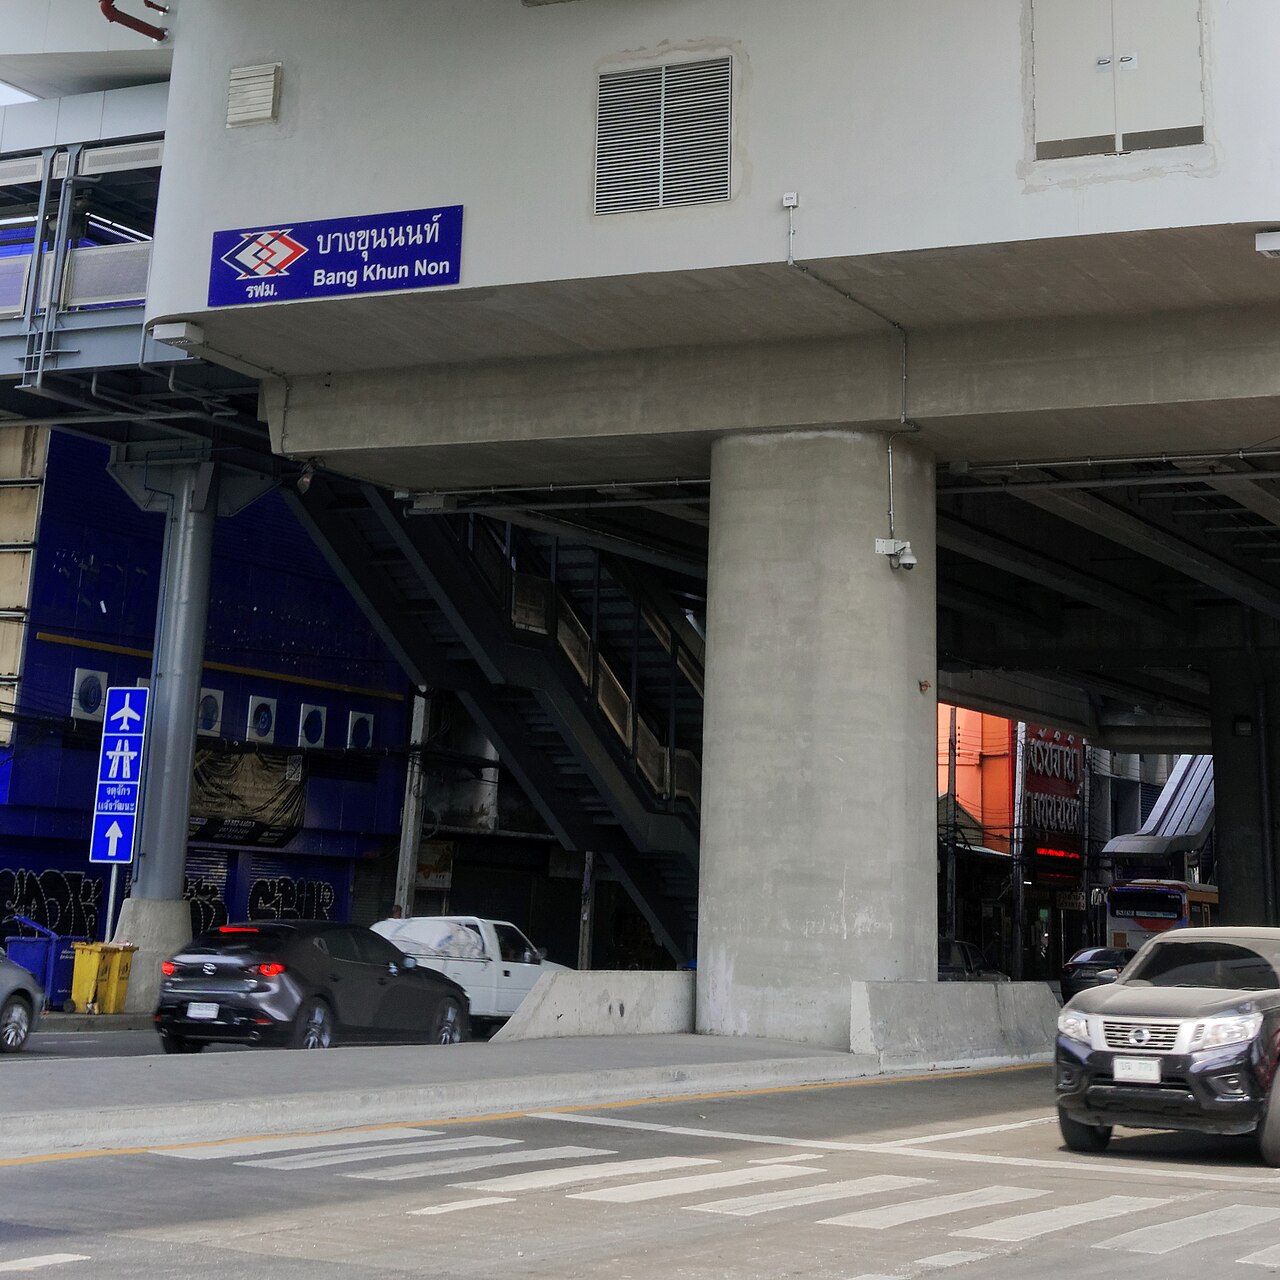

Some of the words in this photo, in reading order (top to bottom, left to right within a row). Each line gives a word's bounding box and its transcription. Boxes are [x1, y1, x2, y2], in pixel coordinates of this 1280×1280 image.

[317, 214, 442, 261] บางขุนนนท์
[313, 269, 358, 289] Bang
[363, 261, 410, 282] Khun
[414, 258, 450, 276] Non
[245, 281, 278, 299] รฟม.
[106, 784, 131, 799] จตุจักร
